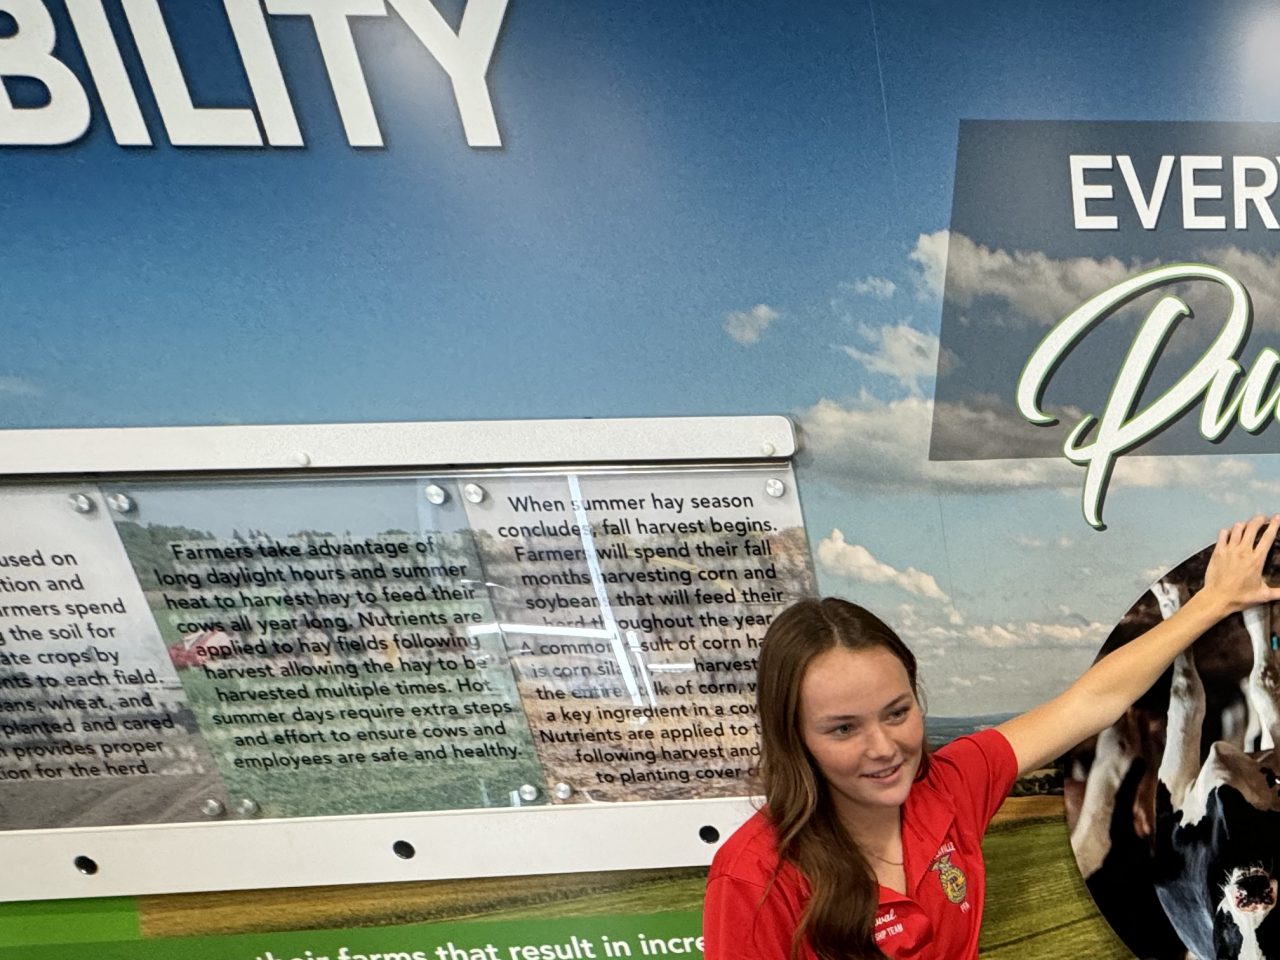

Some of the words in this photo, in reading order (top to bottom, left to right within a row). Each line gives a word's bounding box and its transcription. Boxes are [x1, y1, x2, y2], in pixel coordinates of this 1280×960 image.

[508, 496, 565, 512] When
[651, 493, 683, 513] hay
[691, 497, 753, 508] season
[51, 554, 77, 565] on
[596, 543, 629, 562] will
[634, 542, 690, 564] spend
[695, 541, 738, 557] their
[744, 539, 771, 556] fall
[153, 568, 203, 590] long
[206, 566, 287, 589] daylight
[291, 567, 348, 585] hours
[350, 563, 389, 583] and
[391, 561, 470, 581] summer
[9, 625, 43, 641] the
[49, 623, 83, 639] soil
[87, 623, 115, 638] for
[37, 674, 59, 688] to
[64, 670, 110, 686] each
[113, 669, 164, 684] field.
[212, 713, 286, 728] summer
[292, 707, 337, 725] days
[340, 704, 405, 723] require
[411, 704, 461, 719] extra
[464, 702, 515, 717] steps
[233, 731, 269, 746] and
[273, 729, 327, 744] effort
[330, 730, 351, 742] to
[356, 729, 417, 741] ensure
[422, 727, 468, 738] cows
[474, 721, 507, 736] and
[539, 729, 622, 747] Nutrients
[628, 730, 654, 740] are
[661, 722, 724, 742] applied
[729, 724, 748, 736] to
[234, 752, 332, 771] employees
[338, 753, 366, 766] are
[371, 747, 411, 762] safe
[413, 745, 448, 763] and
[452, 742, 522, 760] healthy.
[574, 748, 658, 766] following
[659, 745, 727, 761] harvest
[729, 742, 763, 759] and
[596, 772, 617, 783] to
[619, 768, 691, 787] planting
[695, 768, 744, 780] cover
[887, 923, 903, 936] TEAM
[602, 936, 631, 957] in
